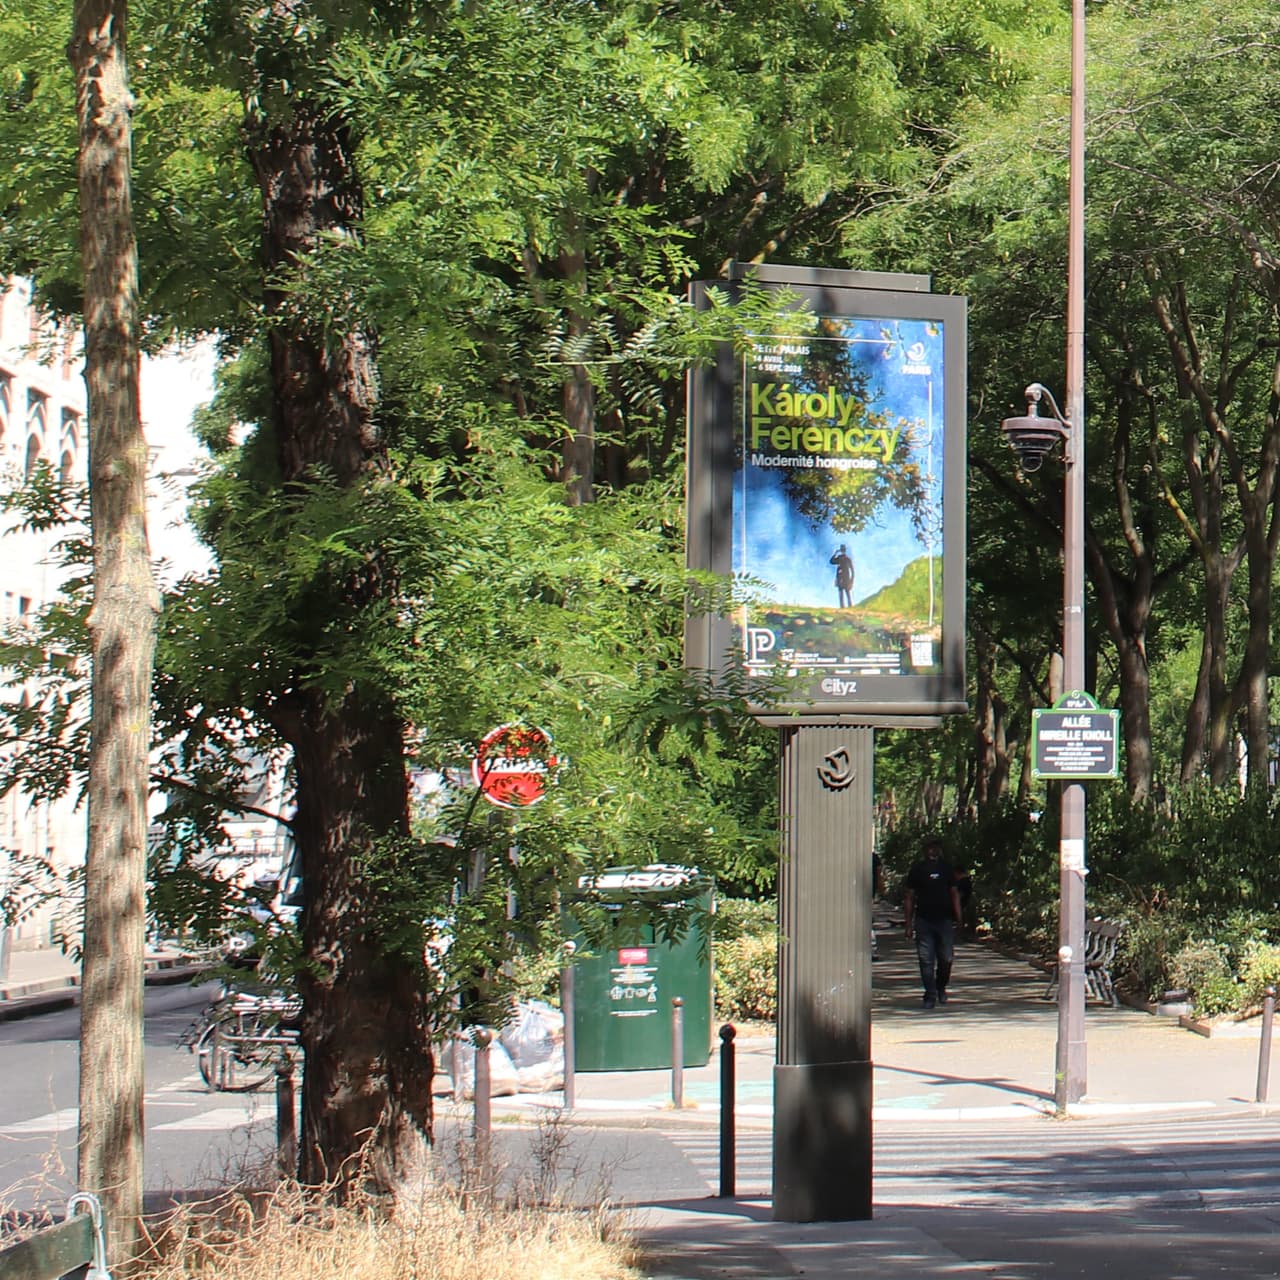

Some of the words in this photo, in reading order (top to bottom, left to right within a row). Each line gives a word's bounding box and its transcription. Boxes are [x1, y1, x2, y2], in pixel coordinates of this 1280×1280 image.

[751, 383, 856, 426] Károly
[751, 417, 899, 462] Ferenczy
[751, 453, 814, 468] Modernité
[815, 455, 878, 470] hongroise
[821, 678, 857, 696] Cityz
[1061, 714, 1092, 728] ALLÉE
[1040, 730, 1081, 740] MIREILLE
[1082, 730, 1113, 741] KNOLL
